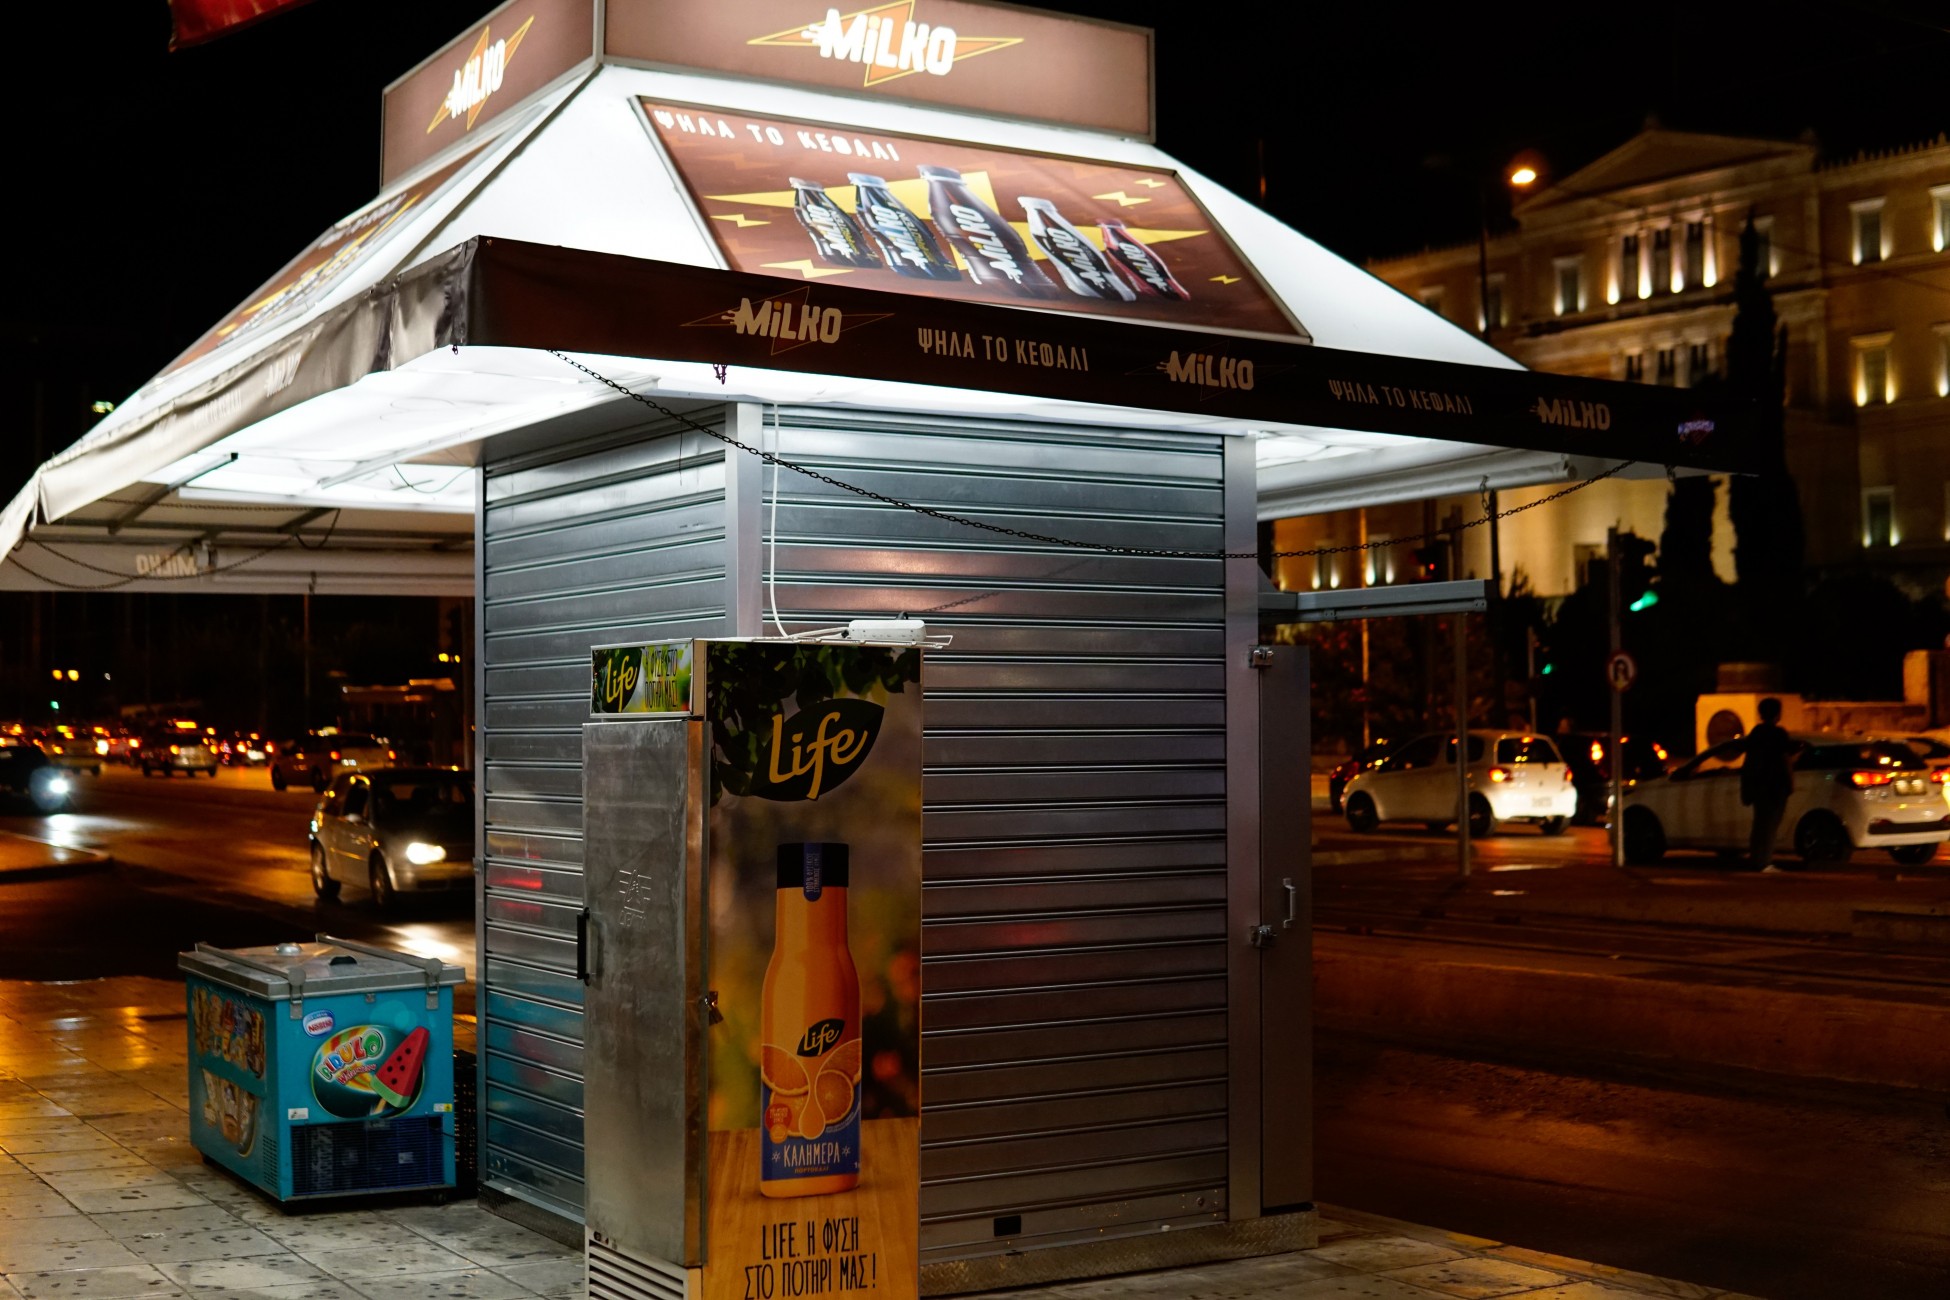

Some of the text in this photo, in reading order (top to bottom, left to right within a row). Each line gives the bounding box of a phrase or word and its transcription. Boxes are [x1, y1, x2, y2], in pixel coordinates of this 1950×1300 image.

[653, 109, 900, 162] ΨΗΛΑ ΤΟ ΚΕΦΑΛΙ
[917, 327, 1089, 372] ΨΗΛΑ ΤΟ ΚΕΦΑΛΙ
[1328, 379, 1473, 415] ΨΗΛΑ ΤΟ ΚΕΦΑΛΙ
[606, 655, 638, 713] Life
[769, 711, 868, 801] Life
[804, 1023, 840, 1056] Life
[783, 1141, 841, 1168] ΚΑΛΗΜΕΡΑ
[762, 1217, 859, 1260] LIFE. Η ΦΥΣΗ
[744, 1263, 774, 1300] ΣΤΟ
[782, 1258, 832, 1297] ΠΟΤΗΡΙ
